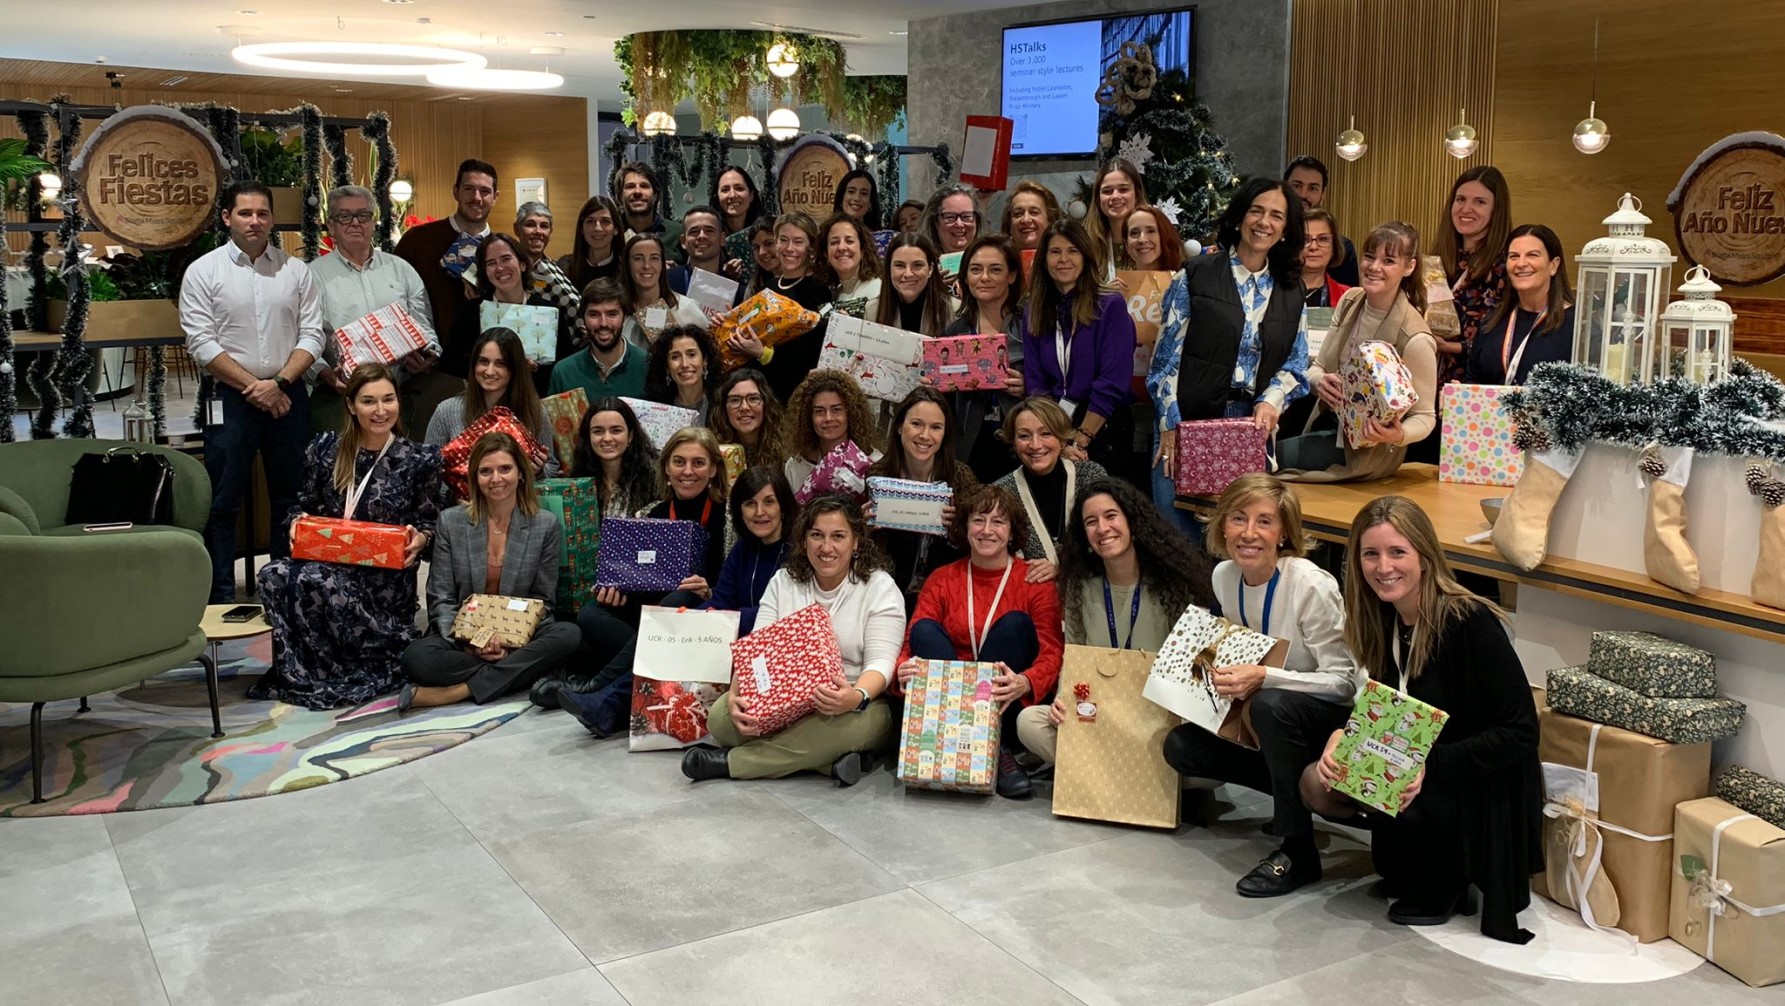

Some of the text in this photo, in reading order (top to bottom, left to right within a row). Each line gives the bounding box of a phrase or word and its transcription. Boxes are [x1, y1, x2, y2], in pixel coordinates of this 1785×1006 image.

[1010, 41, 1047, 54] HSTalks
[1010, 57, 1025, 66] Over
[1010, 65, 1084, 77] seminar-style lectures
[108, 152, 199, 178] Felices
[802, 169, 833, 188] Feliz
[100, 176, 209, 205] Fiestas
[783, 188, 836, 204] Año Nue
[1718, 183, 1775, 210] Feliz
[1683, 211, 1728, 234] Año
[1127, 295, 1162, 323] Re
[703, 635, 722, 644] AÑOS
[1367, 741, 1379, 750] UCR
